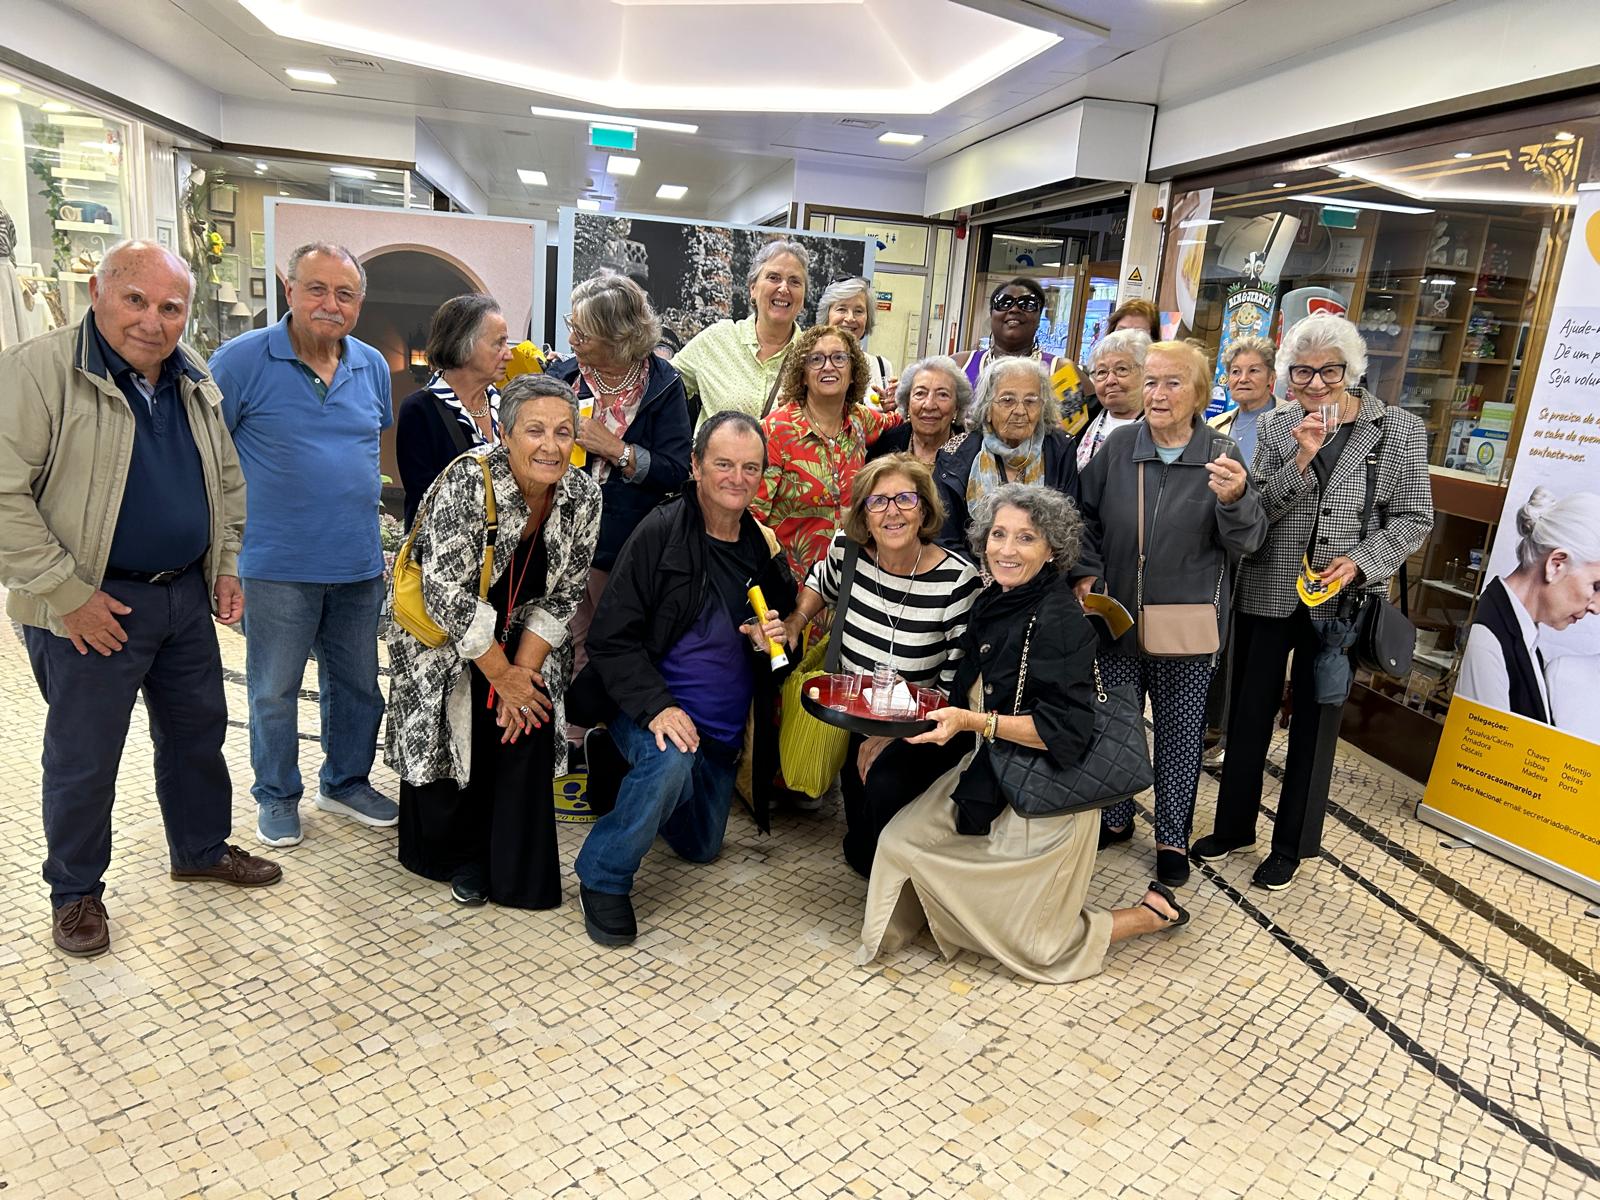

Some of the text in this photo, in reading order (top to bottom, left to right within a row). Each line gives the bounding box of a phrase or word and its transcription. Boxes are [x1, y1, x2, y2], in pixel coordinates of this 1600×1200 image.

[1554, 343, 1571, 360] Dê
[1573, 351, 1589, 360] um
[1549, 368, 1570, 388] Seja
[1539, 407, 1549, 420] Se
[1548, 412, 1581, 423] precisa
[1583, 413, 1594, 424] de
[1566, 430, 1577, 442] de
[1468, 712, 1509, 732] Delegações:
[1463, 735, 1491, 751] Amadora
[1465, 726, 1514, 749] Agualva/Cacém
[1460, 743, 1483, 758] Cascais
[1527, 748, 1550, 763] Chaves
[1524, 758, 1546, 772] Lisboa
[1563, 762, 1592, 778] Montijo
[1456, 762, 1542, 800] www.coracaoamarelo.pt
[1521, 767, 1548, 783] Madeira
[1561, 772, 1584, 786] Oeiras
[1450, 778, 1475, 793] Direção
[1558, 781, 1578, 794] Porto
